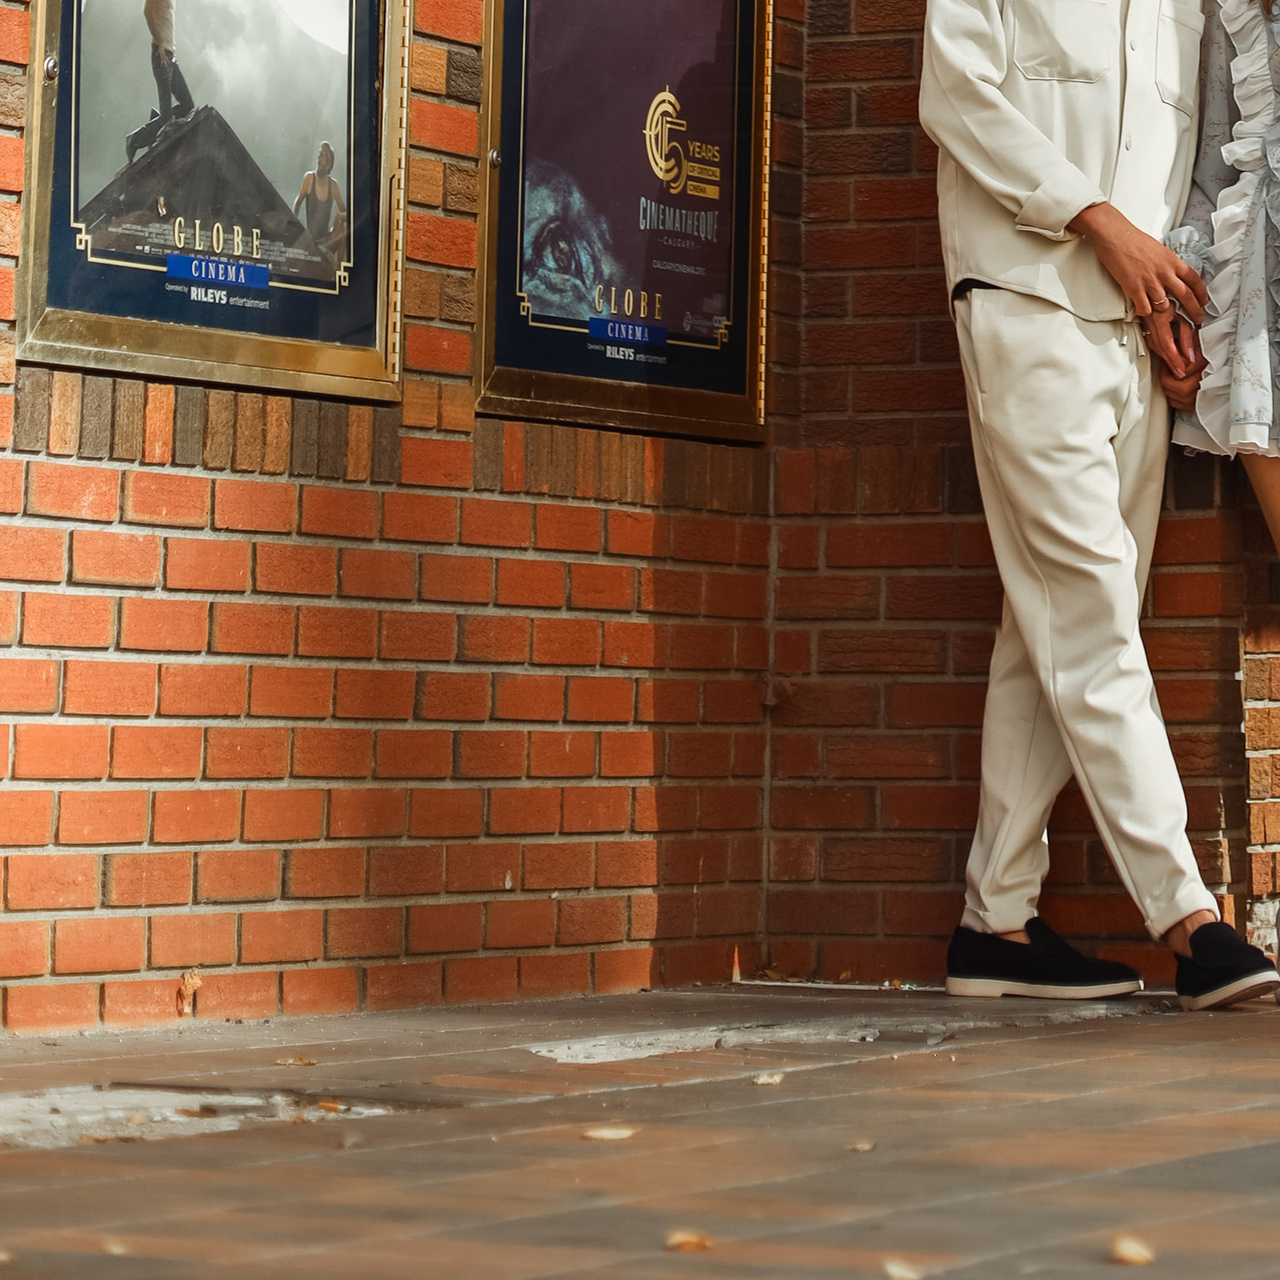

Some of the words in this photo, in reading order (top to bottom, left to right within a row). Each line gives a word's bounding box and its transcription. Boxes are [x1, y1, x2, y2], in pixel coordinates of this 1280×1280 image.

[687, 139, 720, 162] YEARS
[639, 195, 719, 243] CINEMATHEQUE
[173, 216, 261, 260] GLOBE
[191, 259, 246, 284] CINEMA
[190, 286, 228, 305] RILEYS
[229, 295, 270, 310] entertainment
[594, 284, 663, 320] GLOBE
[607, 322, 650, 342] CINEMA
[606, 345, 635, 361] RILEYS
